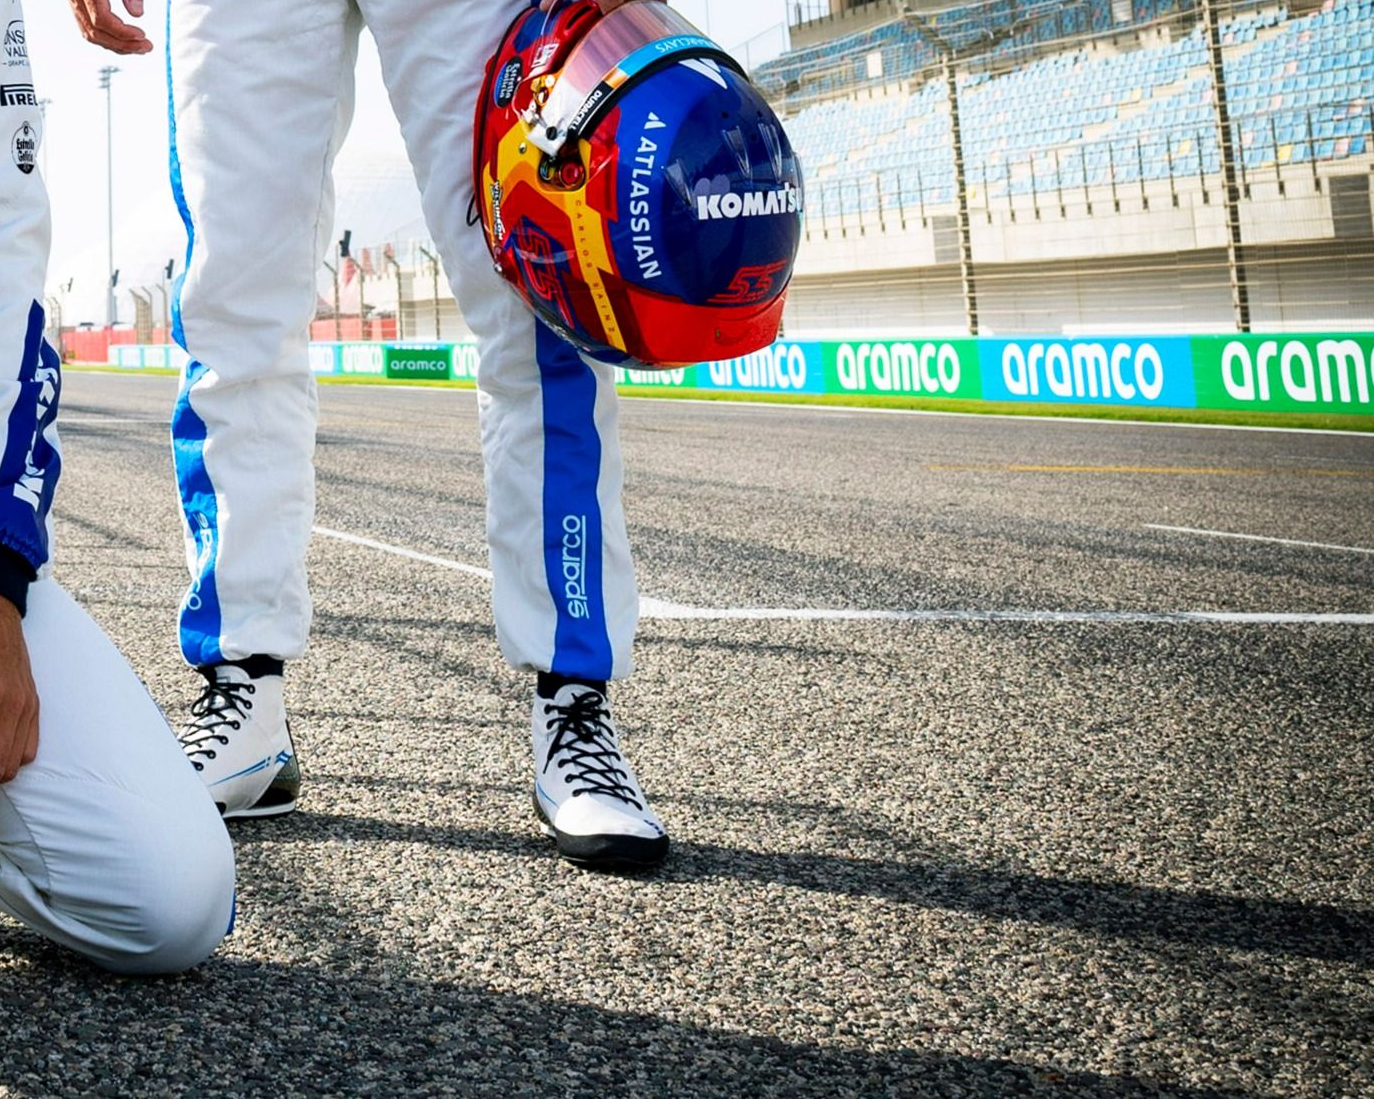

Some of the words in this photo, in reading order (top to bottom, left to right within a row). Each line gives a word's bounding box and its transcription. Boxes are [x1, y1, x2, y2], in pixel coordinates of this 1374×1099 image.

[570, 89, 603, 130] DURACELL
[629, 136, 662, 279] ATLASSIAN
[576, 199, 593, 269] CARLOS
[593, 282, 615, 333] SAINZ
[390, 359, 447, 371] aramco
[837, 342, 961, 393] aramco
[1002, 342, 1164, 400] aramco
[1221, 339, 1374, 404] aram
[562, 514, 590, 620] sparco
